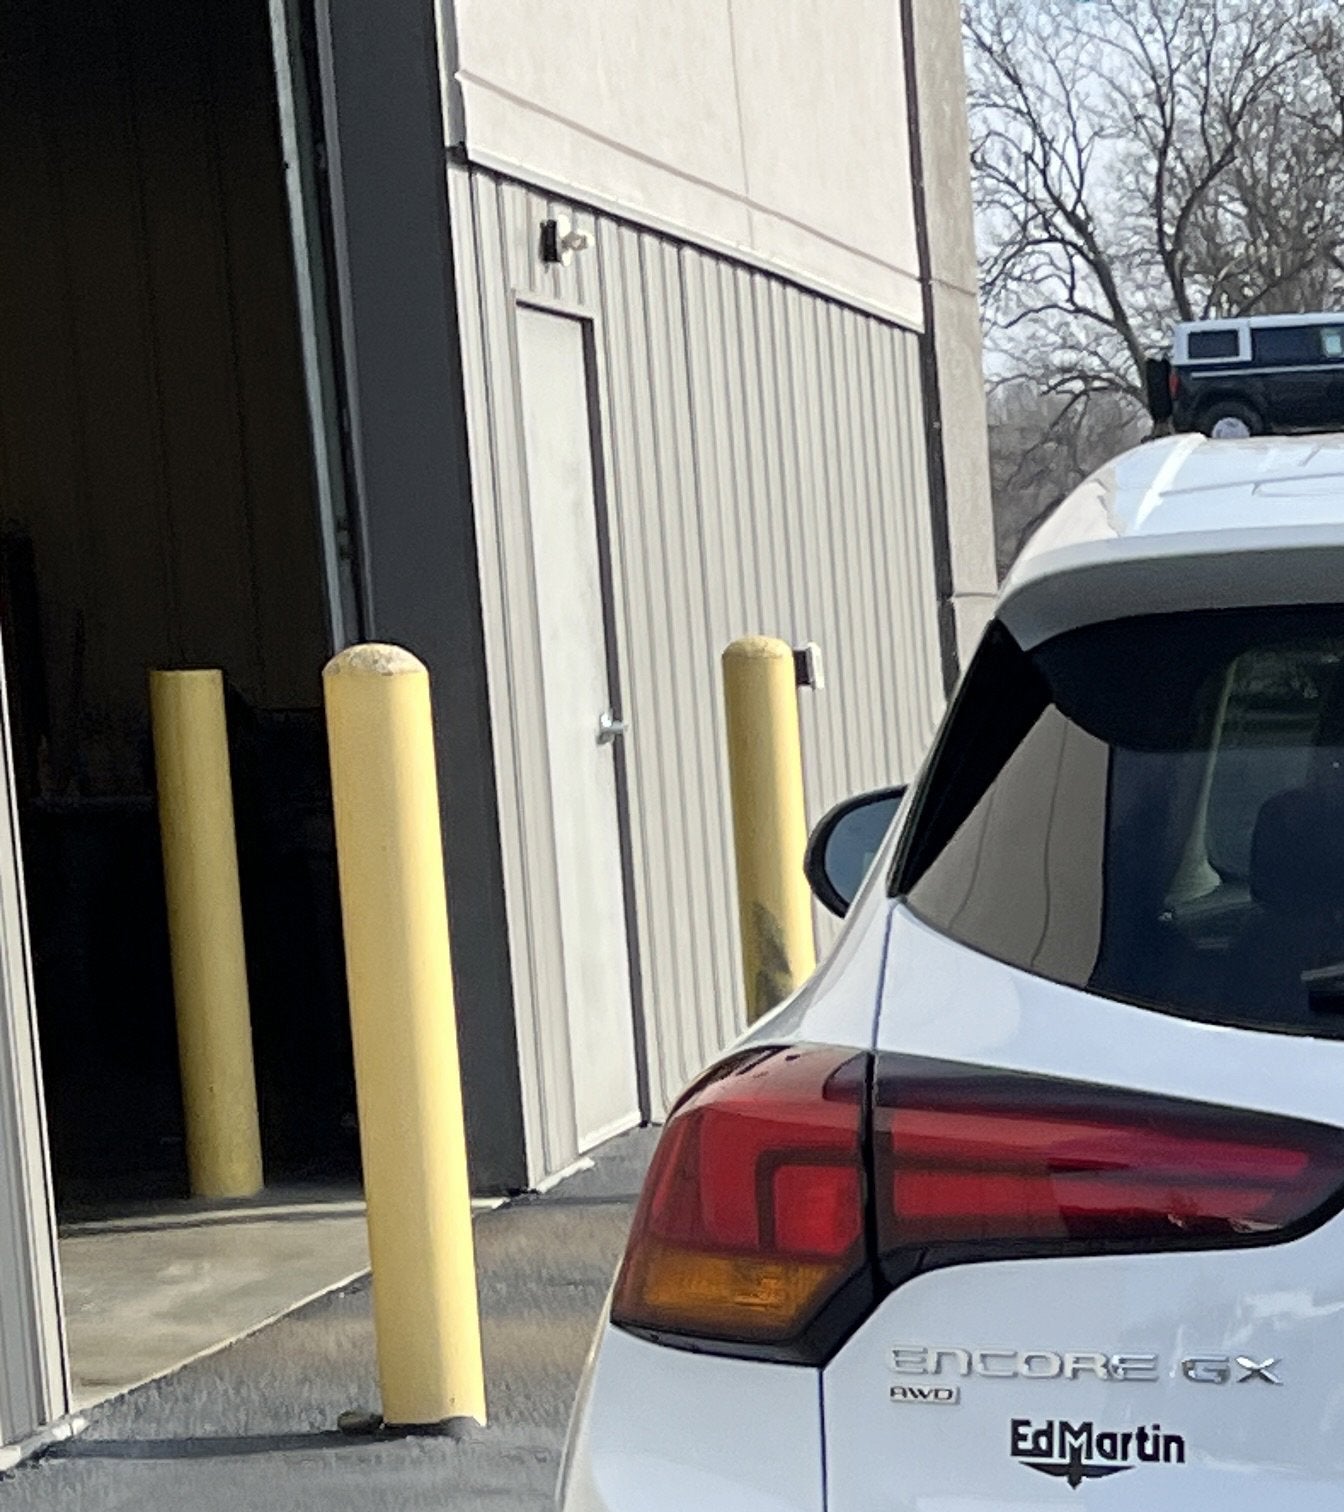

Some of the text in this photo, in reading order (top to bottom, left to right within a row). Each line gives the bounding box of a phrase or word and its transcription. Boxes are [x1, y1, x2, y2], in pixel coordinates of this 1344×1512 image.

[889, 1345, 1284, 1386] ENCORE GX
[889, 1385, 955, 1402] AWD
